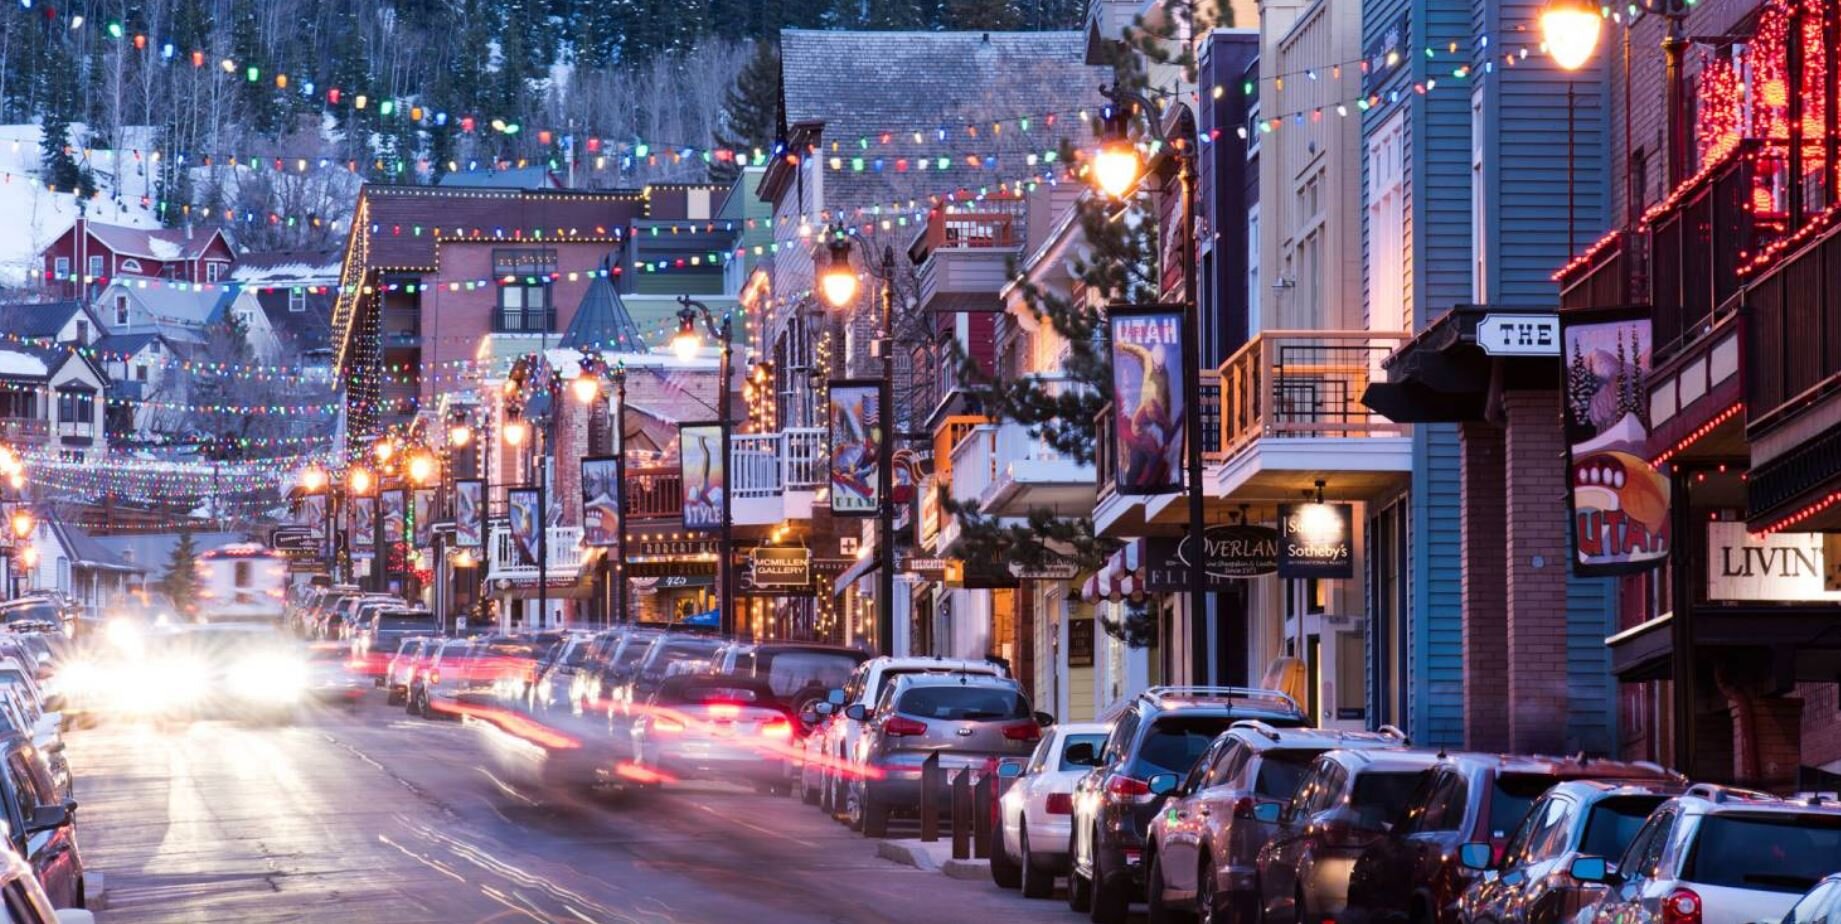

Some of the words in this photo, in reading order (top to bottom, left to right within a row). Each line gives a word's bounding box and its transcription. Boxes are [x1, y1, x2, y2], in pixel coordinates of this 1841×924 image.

[1116, 318, 1177, 344] UTAH
[1500, 324, 1552, 345] THE
[835, 496, 876, 507] UTAH
[685, 504, 721, 524] STYLE
[1578, 510, 1672, 556] UTAH
[1203, 537, 1278, 558] VERLAN
[1288, 543, 1348, 561] Sotheby's
